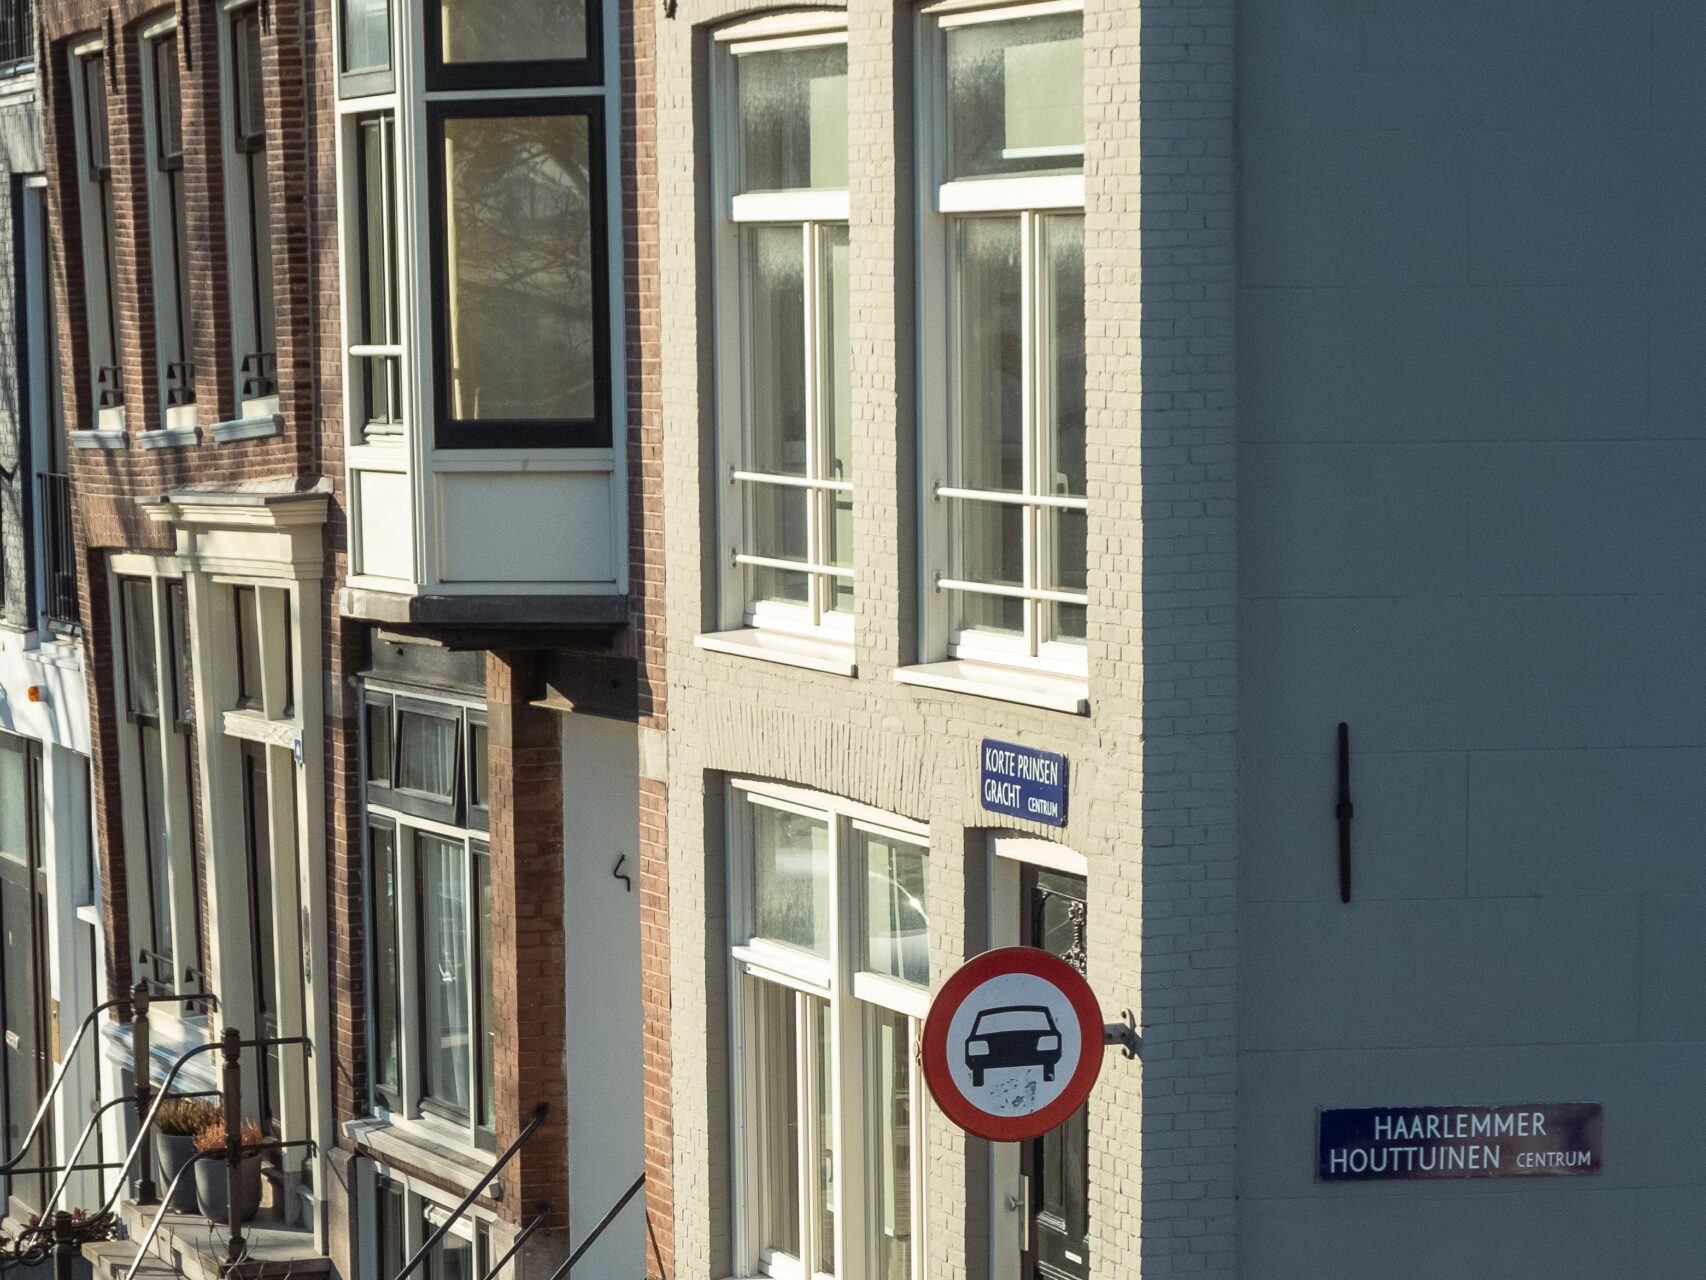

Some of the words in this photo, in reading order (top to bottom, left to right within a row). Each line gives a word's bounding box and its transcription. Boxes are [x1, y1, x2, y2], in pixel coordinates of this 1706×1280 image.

[985, 747, 1015, 777] KORTE
[1018, 754, 1058, 786] PRINSEN
[984, 779, 1021, 808] GRACHT
[1028, 796, 1058, 818] CENTRUM
[1375, 1112, 1547, 1140] HAARLEMMER
[1330, 1145, 1500, 1173] HOUTTUINEN
[1516, 1151, 1591, 1168] CENTRUM
